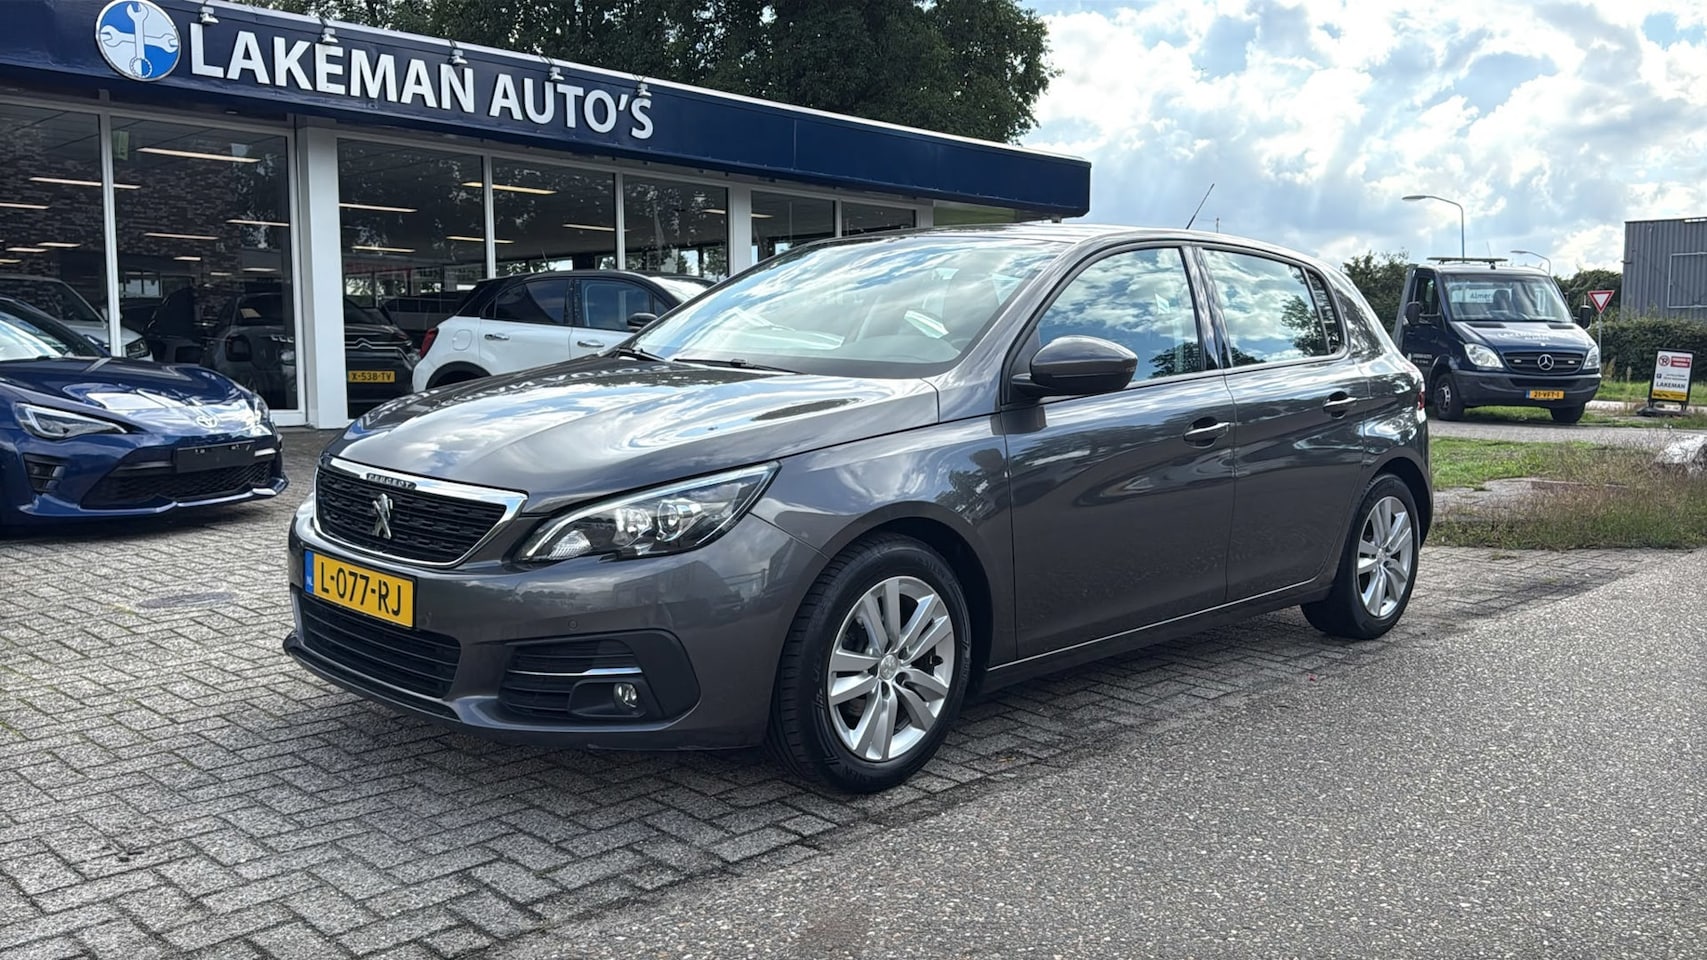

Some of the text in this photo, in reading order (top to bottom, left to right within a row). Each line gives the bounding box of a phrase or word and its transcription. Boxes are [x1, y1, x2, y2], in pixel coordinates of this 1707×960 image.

[189, 23, 655, 140] LAKEMAN AUTO'S
[1470, 291, 1493, 299] Almer
[1656, 381, 1686, 389] LAKEMAN
[368, 474, 411, 488] PEUGEOT
[321, 562, 401, 616] L-077-RJ
